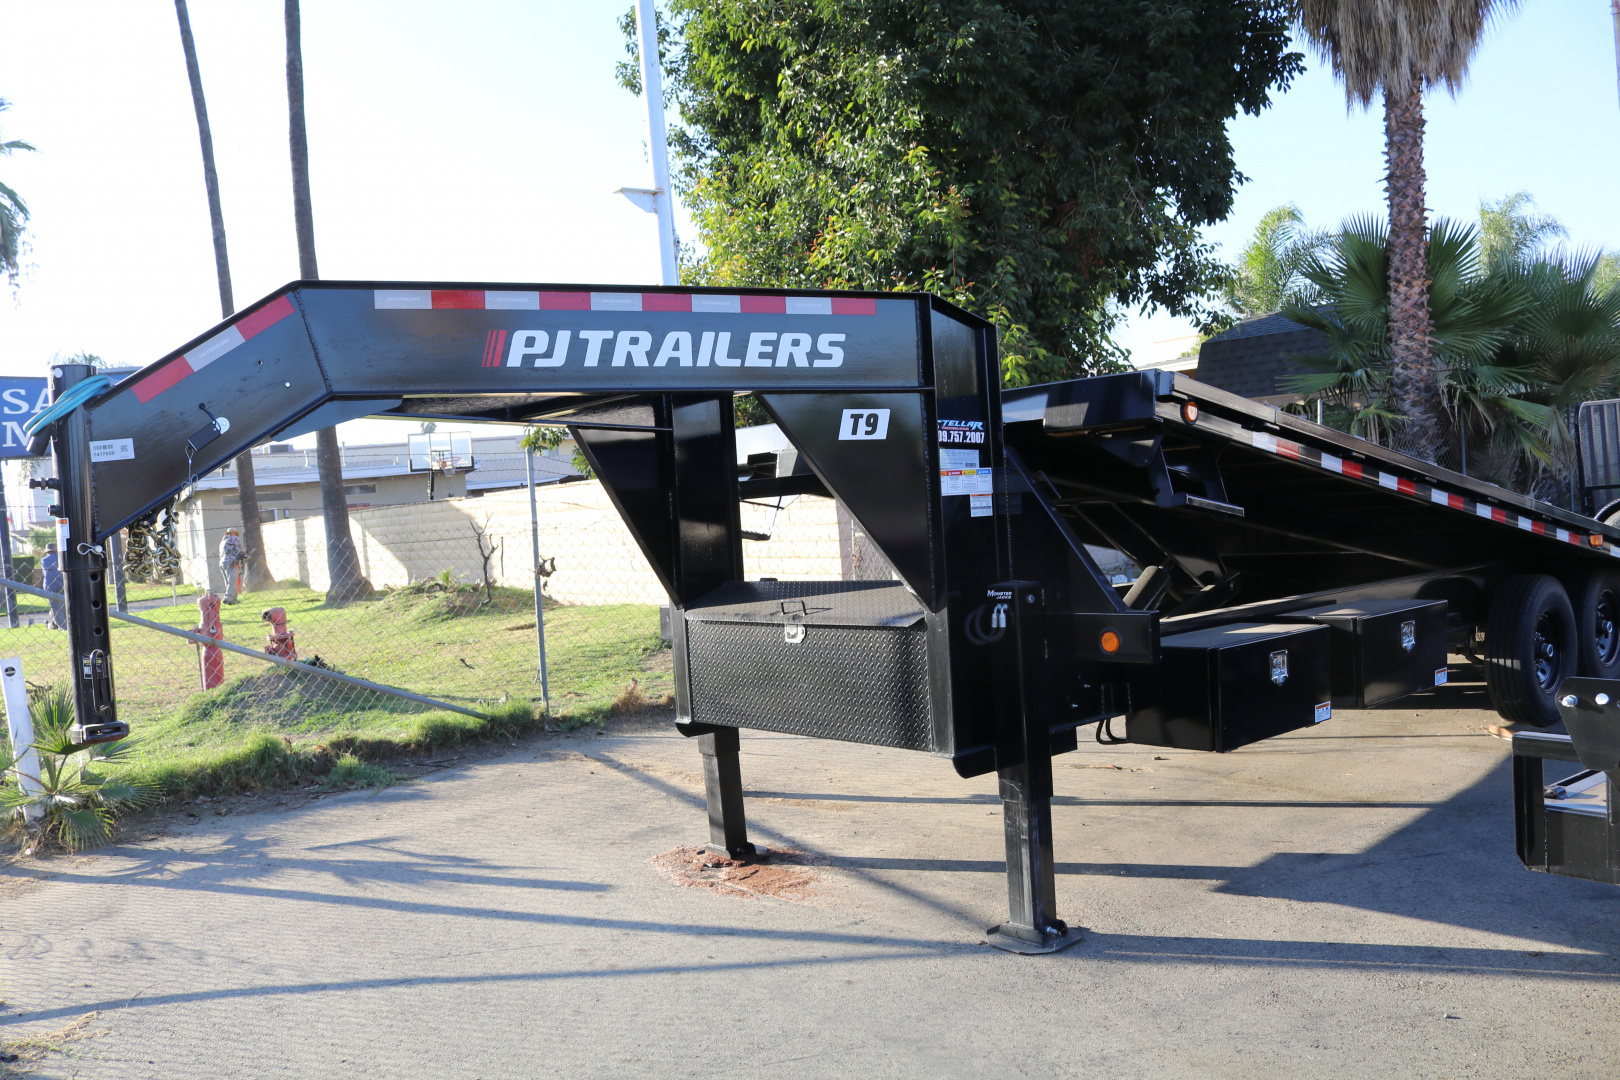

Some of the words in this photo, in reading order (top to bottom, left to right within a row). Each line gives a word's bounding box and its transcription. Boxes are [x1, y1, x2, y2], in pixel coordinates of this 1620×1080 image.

[506, 330, 571, 367] PJ
[579, 330, 846, 368] TRAILERS
[850, 413, 879, 436] T9
